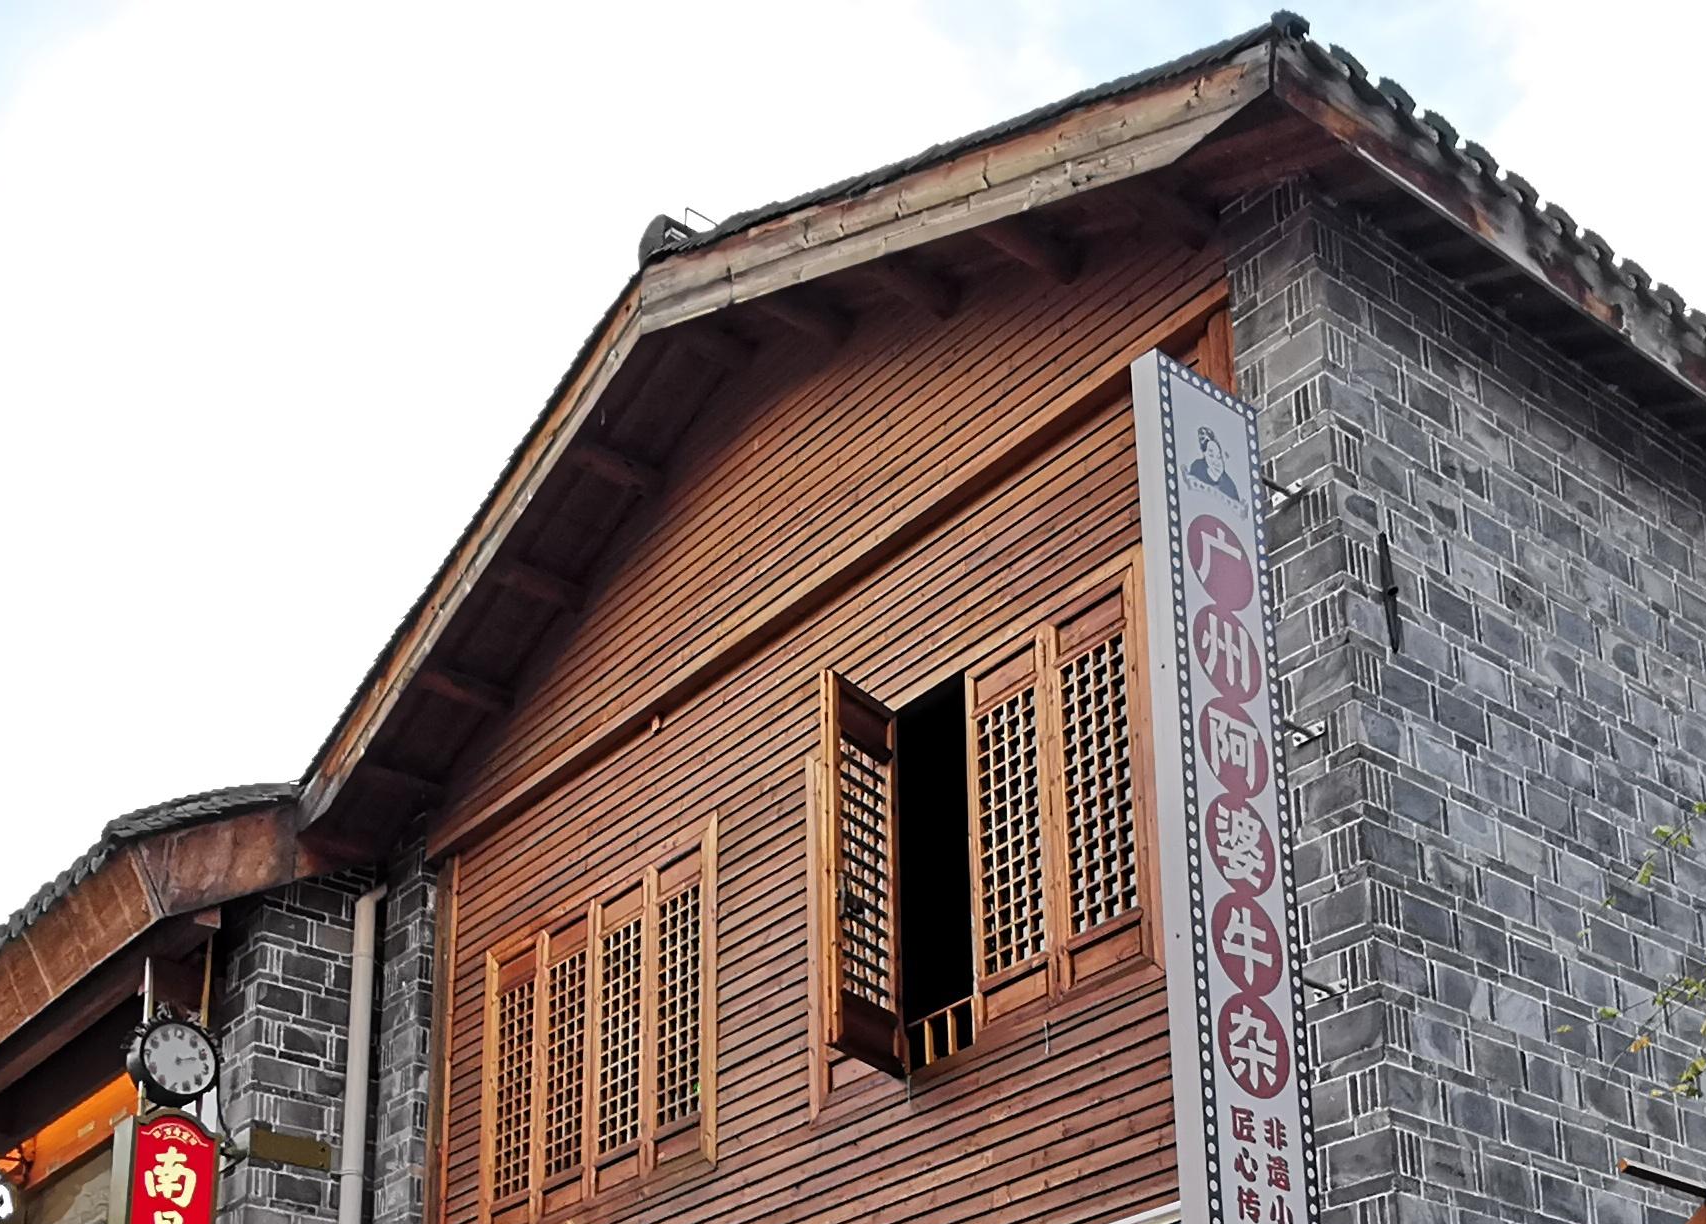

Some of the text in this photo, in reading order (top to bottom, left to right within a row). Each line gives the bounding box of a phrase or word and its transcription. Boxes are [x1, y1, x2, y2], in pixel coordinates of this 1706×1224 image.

[1197, 526, 1280, 1088] 广州阿婆牛杂
